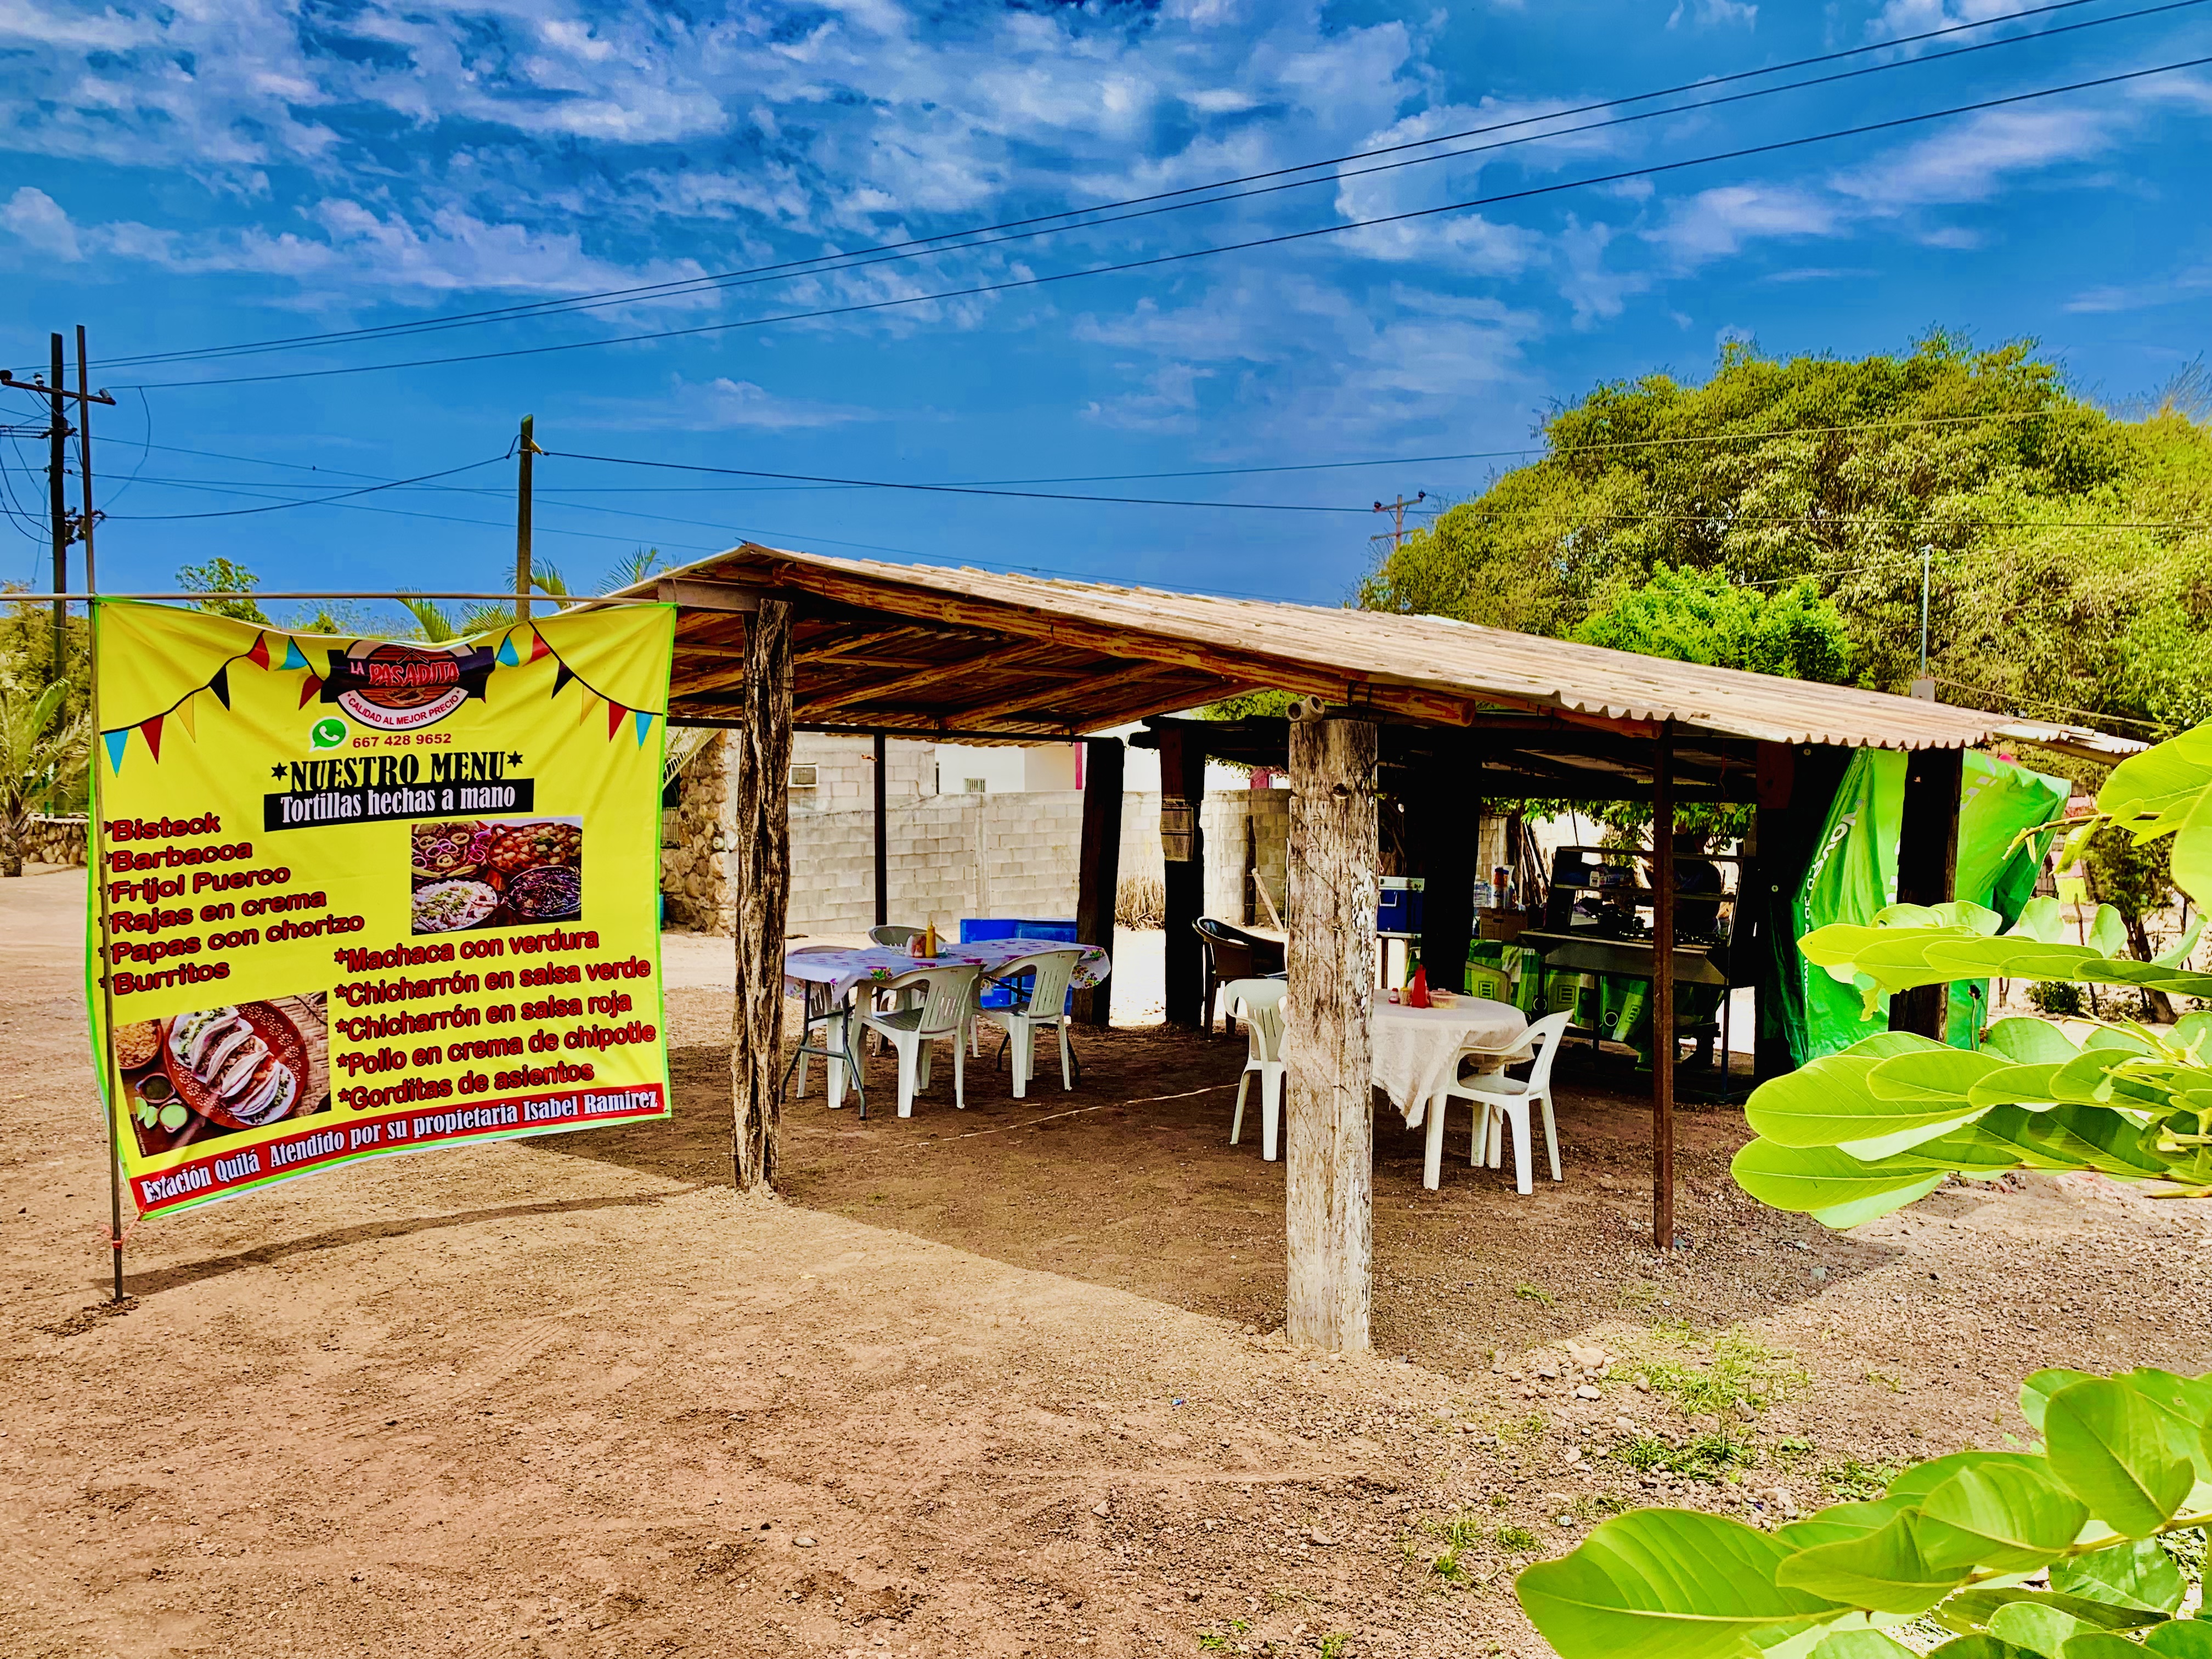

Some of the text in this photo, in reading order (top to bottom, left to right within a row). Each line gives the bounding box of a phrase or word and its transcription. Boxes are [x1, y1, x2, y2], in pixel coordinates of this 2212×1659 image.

[351, 662, 460, 686] LA PASADITA
[348, 695, 459, 725] CALIDAD AL MEJOR PRECIO
[352, 733, 452, 748] 667 428 9652
[280, 786, 515, 823] Tortillas hechas a mano
[192, 867, 291, 894] Puerco
[200, 902, 235, 922] en
[241, 891, 328, 917] crema
[207, 928, 259, 951] con
[265, 913, 365, 943] chorizo
[459, 938, 504, 960] con
[508, 928, 600, 955] verdura
[484, 970, 515, 991] en
[519, 962, 582, 988] salsa
[585, 955, 651, 982] verde
[486, 1003, 516, 1024] en
[521, 994, 583, 1021] salsa
[588, 989, 633, 1019] roja
[411, 1046, 442, 1067] en
[447, 1036, 524, 1062] crema
[528, 1029, 560, 1053] de
[563, 1020, 656, 1052] chipotle
[458, 1070, 489, 1095] de
[493, 1060, 595, 1091] asientos
[140, 1165, 212, 1204] Estación
[215, 1148, 261, 1183] Quilá
[269, 1131, 345, 1167] Atendido
[349, 1124, 381, 1149] por
[387, 1120, 408, 1139] su
[413, 1103, 518, 1138] propietaria
[523, 1096, 579, 1121] Isabel
